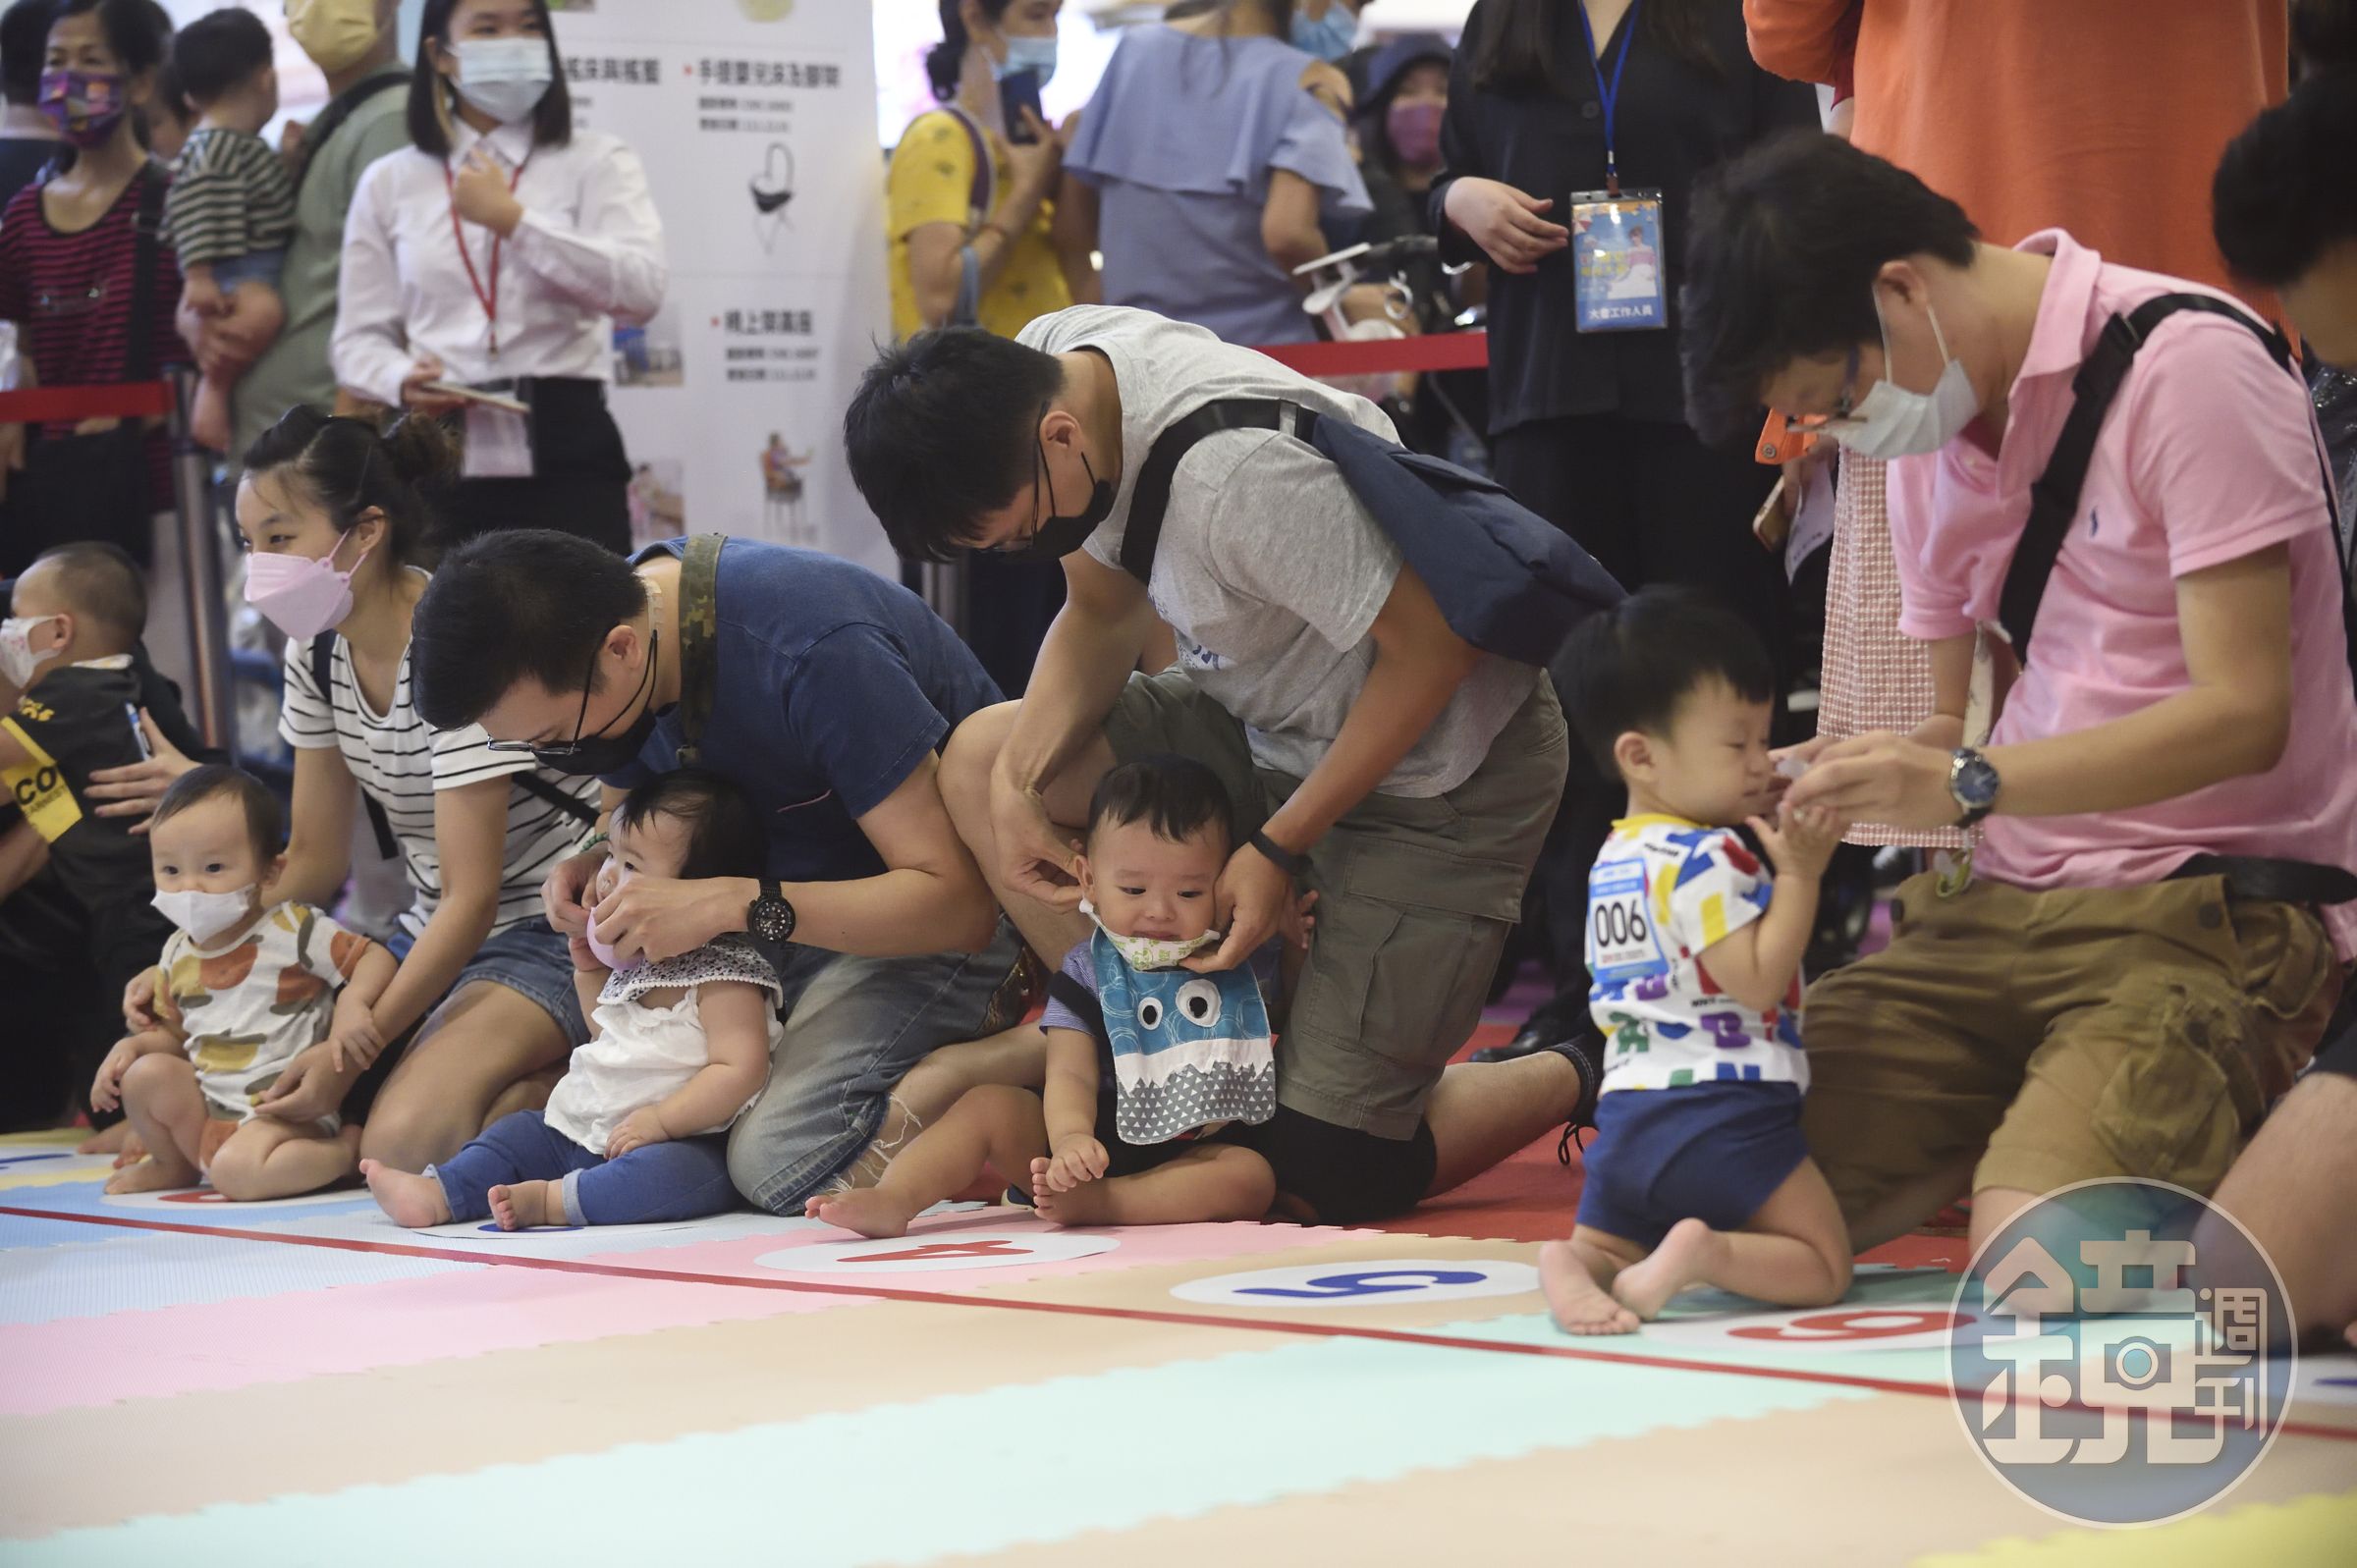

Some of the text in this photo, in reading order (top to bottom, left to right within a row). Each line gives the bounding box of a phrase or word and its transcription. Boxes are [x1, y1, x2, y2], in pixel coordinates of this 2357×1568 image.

[1595, 899, 1647, 947] 006
[837, 1240, 1034, 1263] 4
[1233, 1270, 1488, 1299] 5
